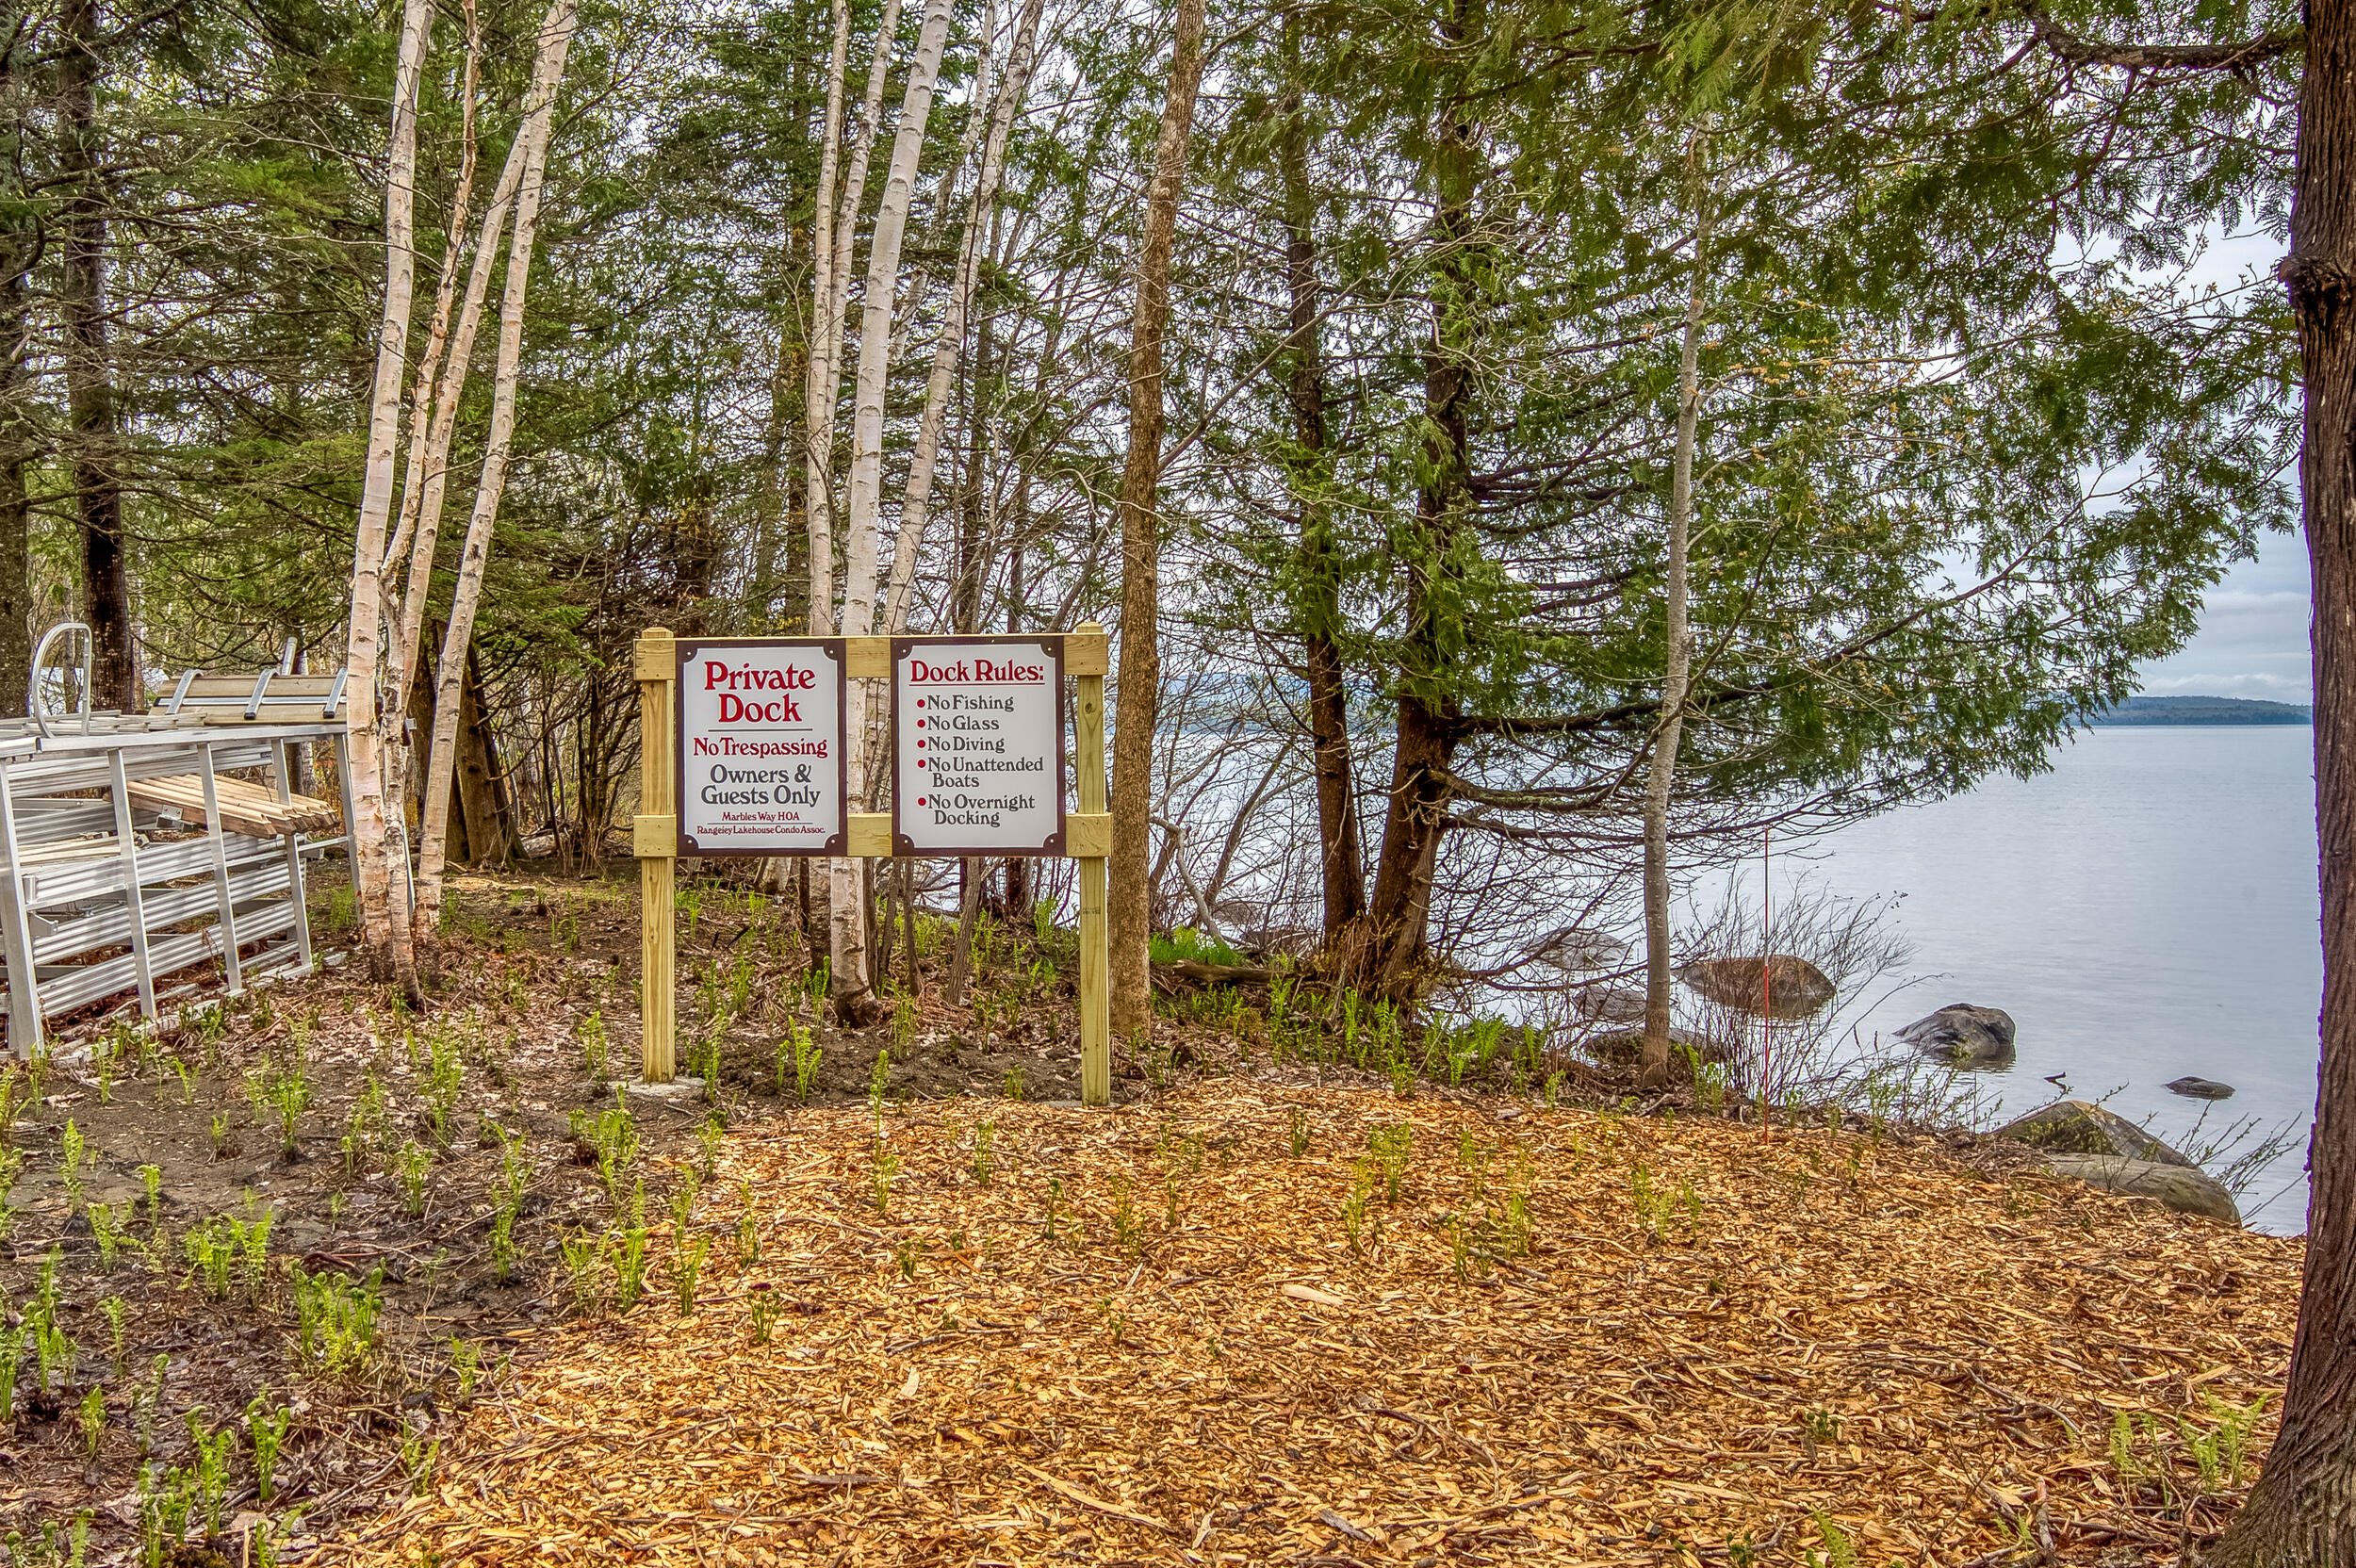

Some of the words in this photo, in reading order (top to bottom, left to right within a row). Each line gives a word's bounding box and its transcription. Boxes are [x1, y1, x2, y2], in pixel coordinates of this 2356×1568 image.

[704, 661, 816, 691] Private
[909, 660, 971, 682] Dock
[973, 659, 1045, 682] Rules:
[718, 693, 803, 723] Dock
[926, 694, 951, 710] No
[952, 694, 1015, 712] Fishing
[926, 715, 951, 731] No
[952, 714, 1000, 731] Glass
[693, 737, 718, 757] No
[719, 737, 828, 760] Trespassing
[927, 736, 951, 752] No
[952, 736, 1006, 754] Diving
[710, 763, 790, 784] Owners
[794, 763, 811, 784] &
[927, 757, 951, 773] No
[953, 756, 1044, 773] Unattended
[932, 773, 980, 788] Boats
[700, 784, 770, 805] Guests
[774, 784, 822, 808] Only
[927, 793, 952, 809] No
[954, 793, 1036, 812] Overnight
[721, 811, 757, 822] Marbles
[758, 811, 777, 824] Way
[777, 811, 800, 822] HOA
[934, 809, 1001, 828] Docking
[733, 825, 775, 835] Lakehouse
[775, 825, 800, 835] Condo
[800, 825, 826, 835] Assoc.
